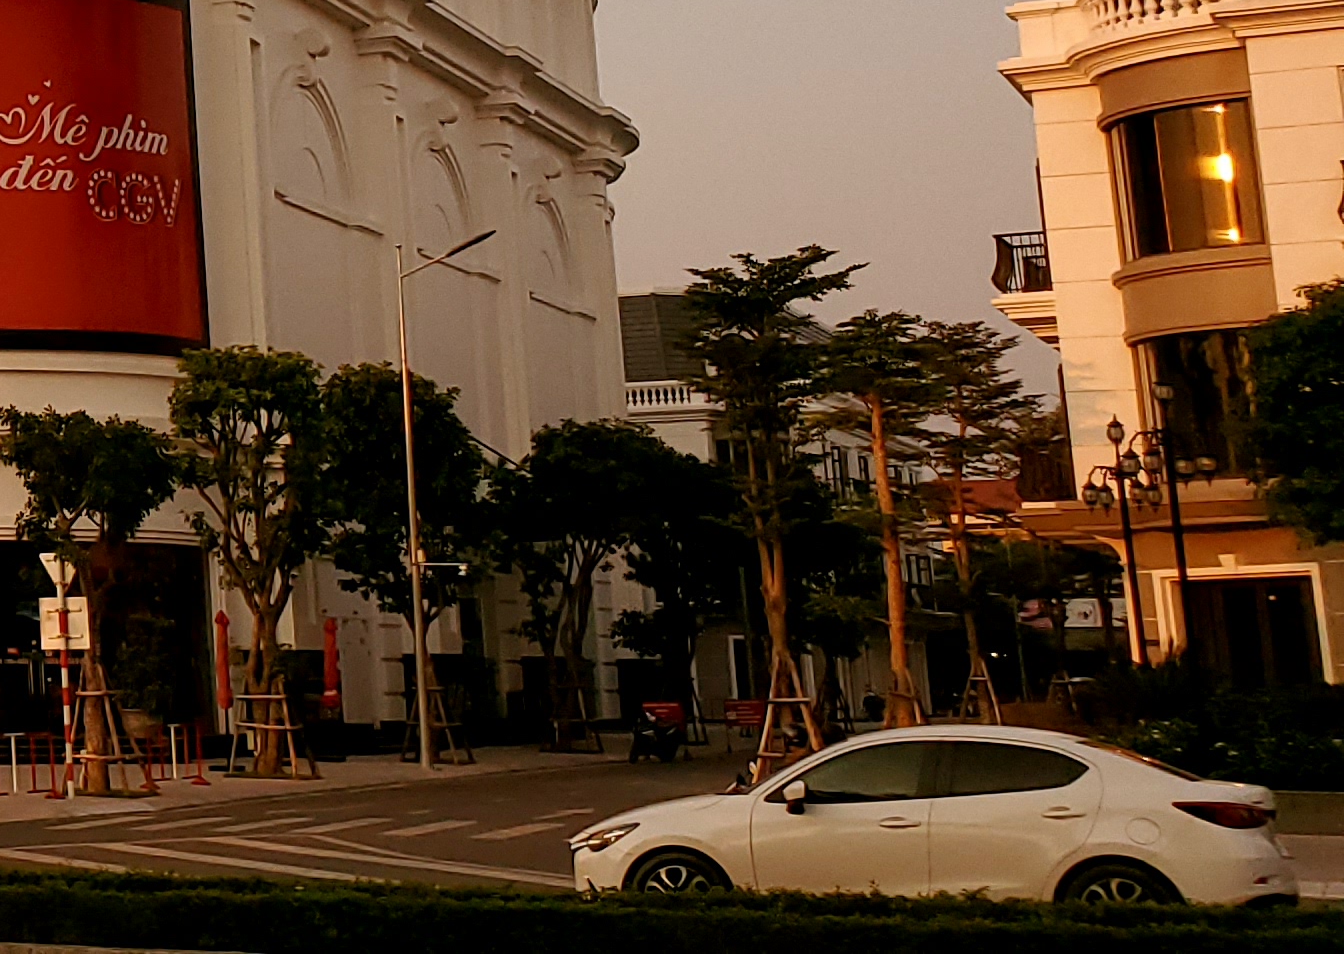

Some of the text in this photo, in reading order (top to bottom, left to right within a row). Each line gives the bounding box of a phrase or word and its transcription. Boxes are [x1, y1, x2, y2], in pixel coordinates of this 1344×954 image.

[79, 114, 168, 161] phim
[0, 155, 181, 227] đến CGV
